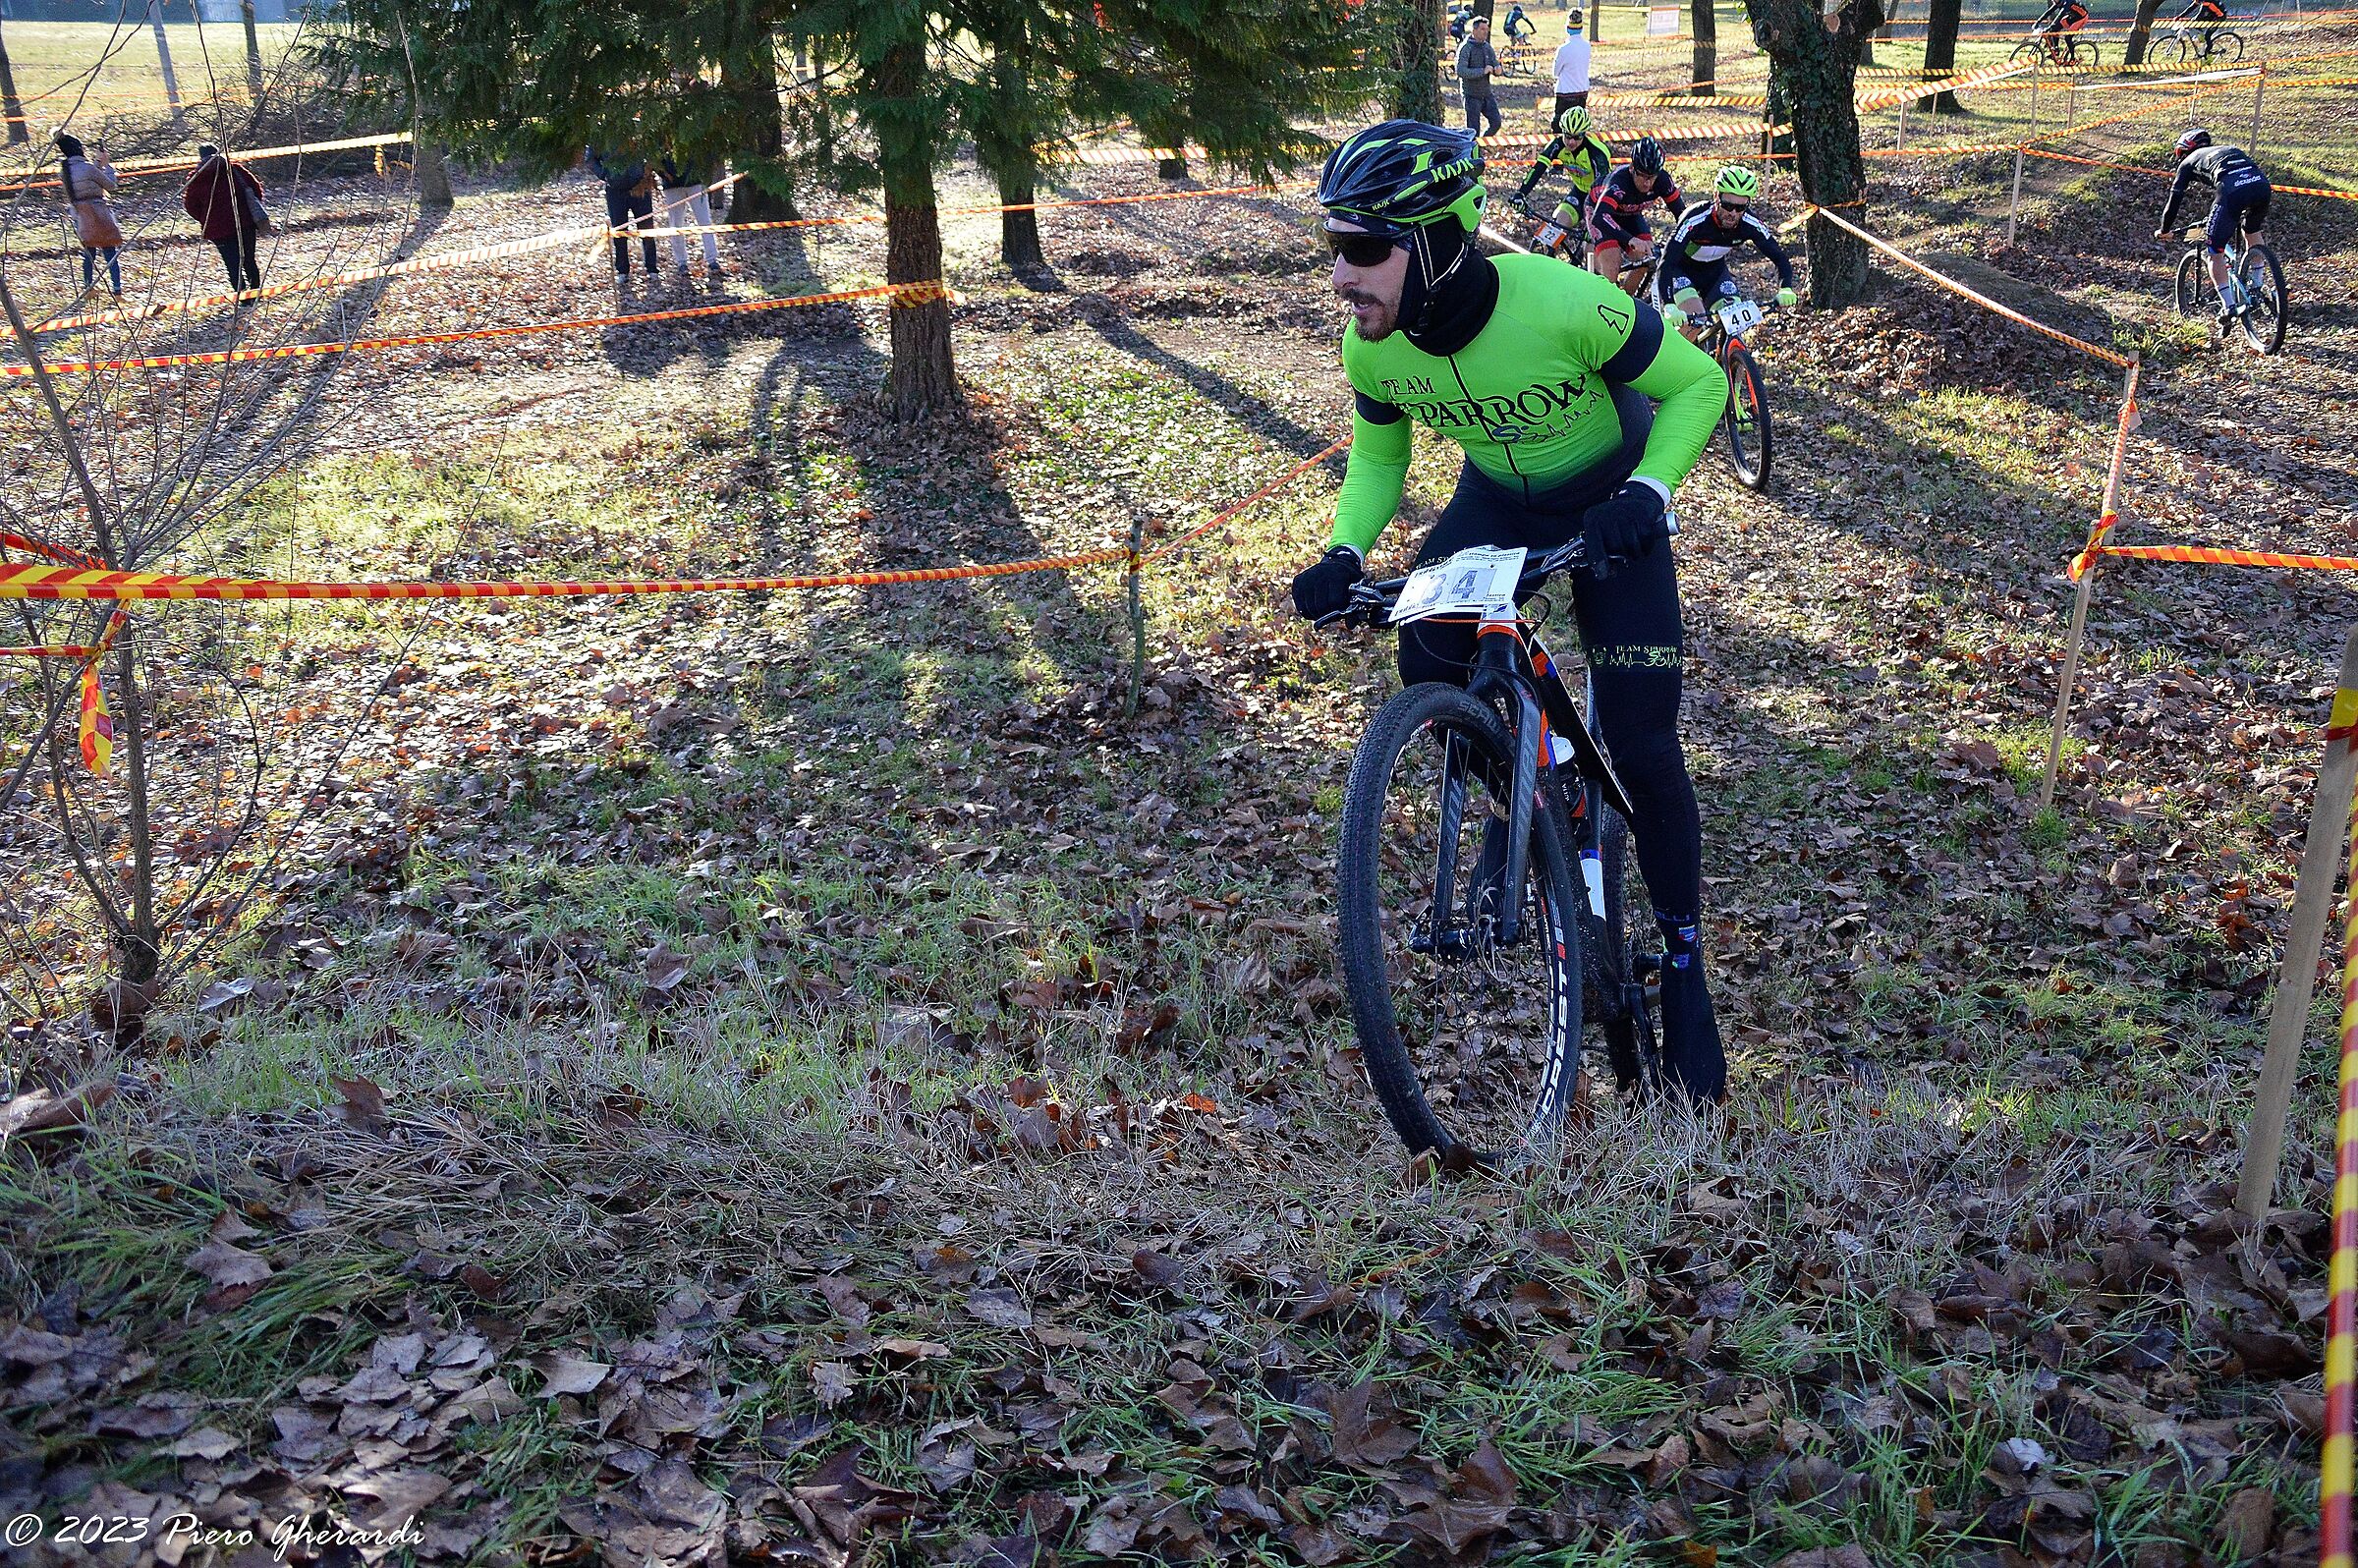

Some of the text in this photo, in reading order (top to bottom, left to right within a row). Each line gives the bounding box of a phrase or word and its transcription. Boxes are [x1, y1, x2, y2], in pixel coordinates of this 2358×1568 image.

[1431, 157, 1475, 183] KASK
[1372, 199, 1390, 211] KASK
[1544, 230, 1556, 241] 22
[1731, 308, 1752, 326] 40
[1379, 374, 1436, 401] TEAM
[1422, 570, 1478, 604] 34
[1615, 644, 1641, 653] TEAM
